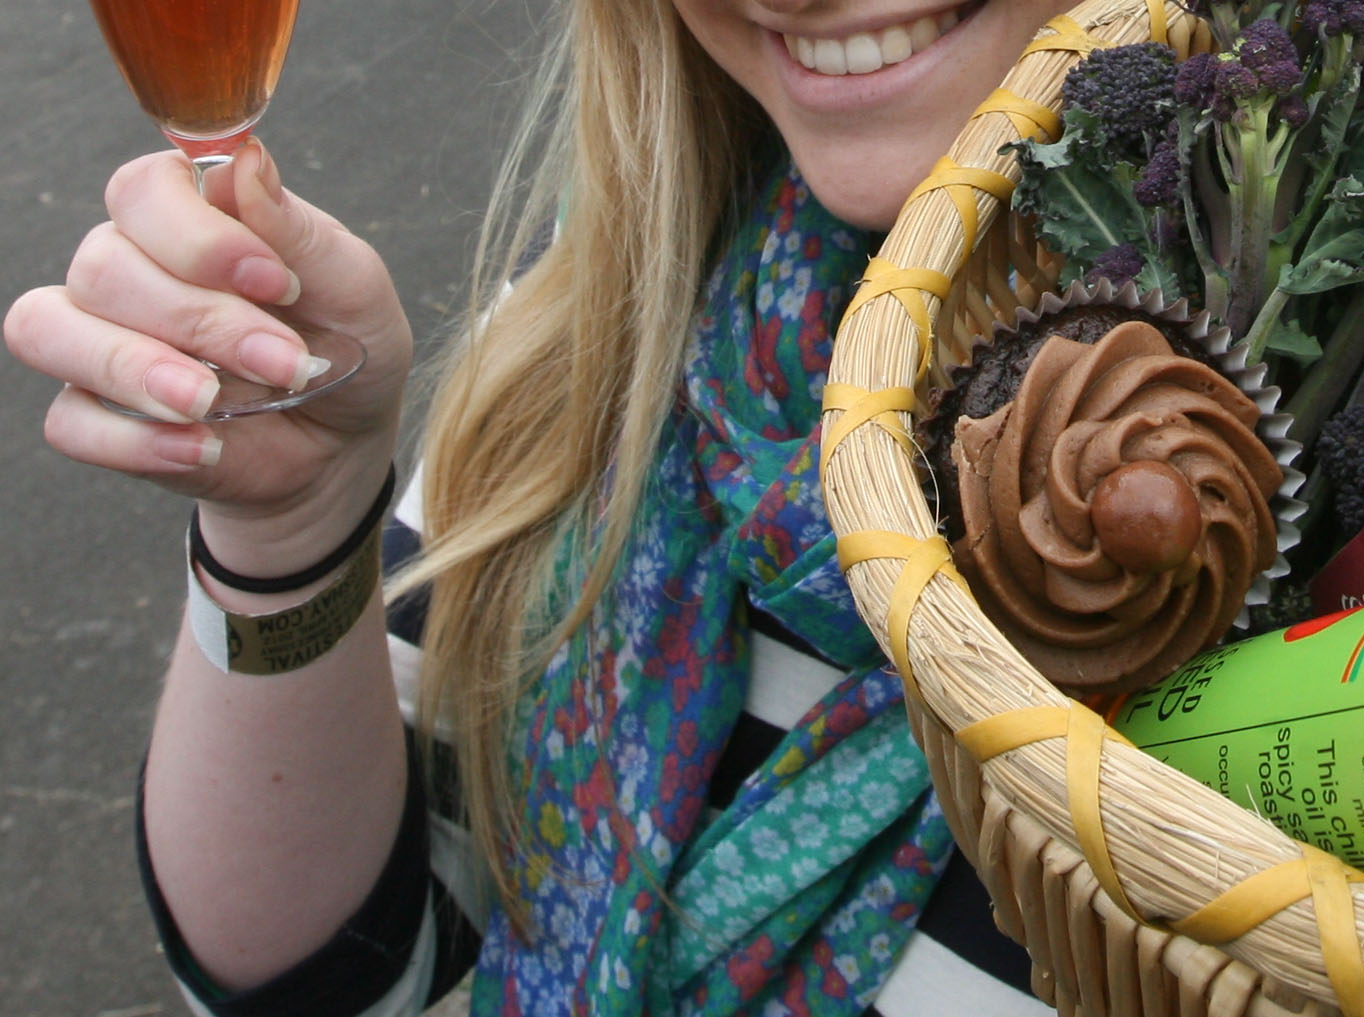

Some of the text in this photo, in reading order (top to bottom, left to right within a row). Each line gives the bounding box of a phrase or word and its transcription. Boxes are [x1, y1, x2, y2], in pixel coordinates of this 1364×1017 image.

[1126, 687, 1162, 724] IL
[1217, 744, 1232, 800] occu
[1273, 726, 1295, 803] spicy
[1316, 738, 1340, 806] This
[1301, 787, 1334, 853] oil is
